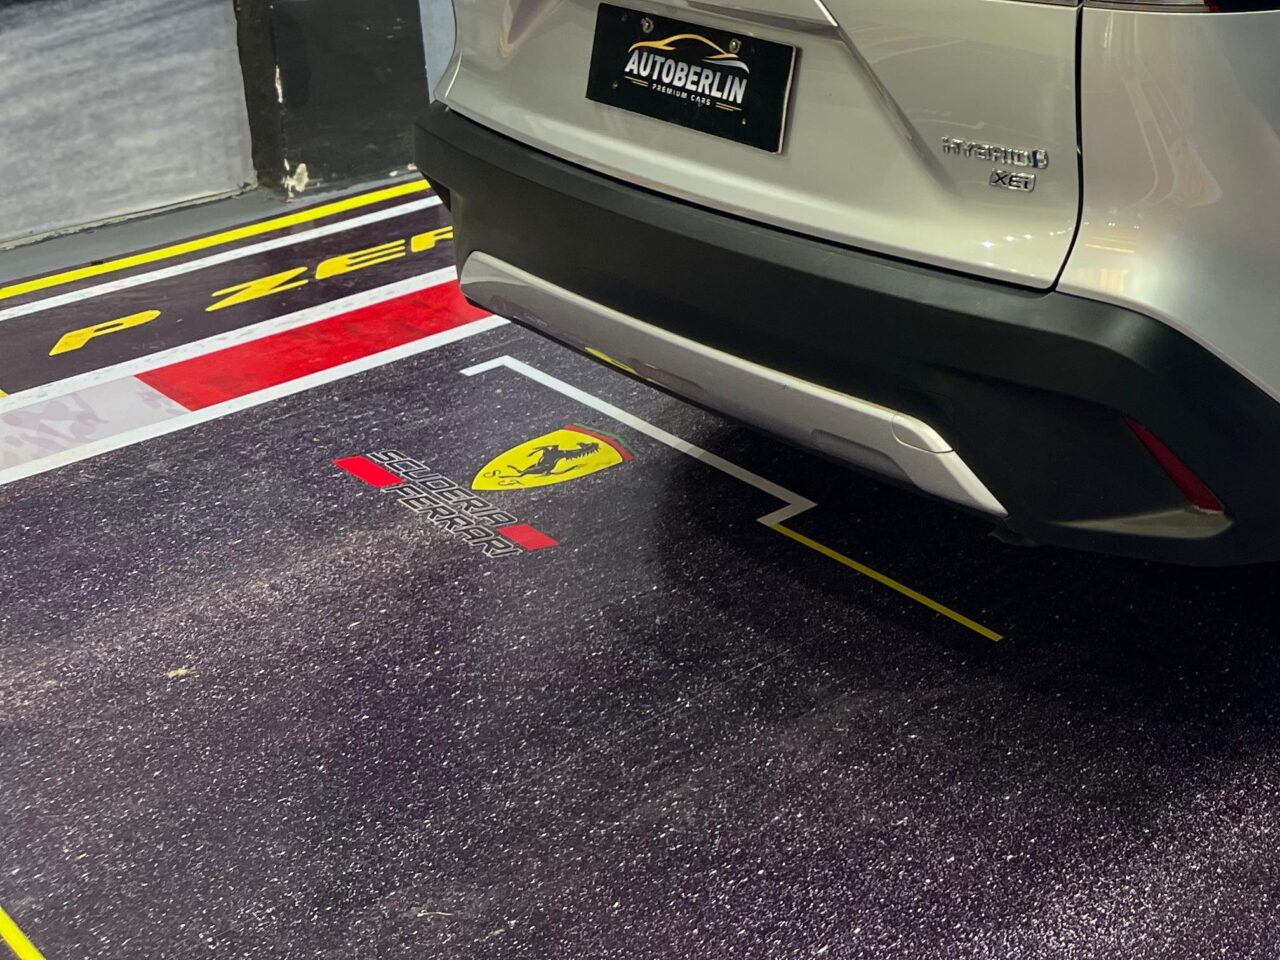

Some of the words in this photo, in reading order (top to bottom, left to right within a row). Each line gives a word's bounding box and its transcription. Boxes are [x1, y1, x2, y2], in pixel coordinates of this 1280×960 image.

[624, 49, 747, 104] AUTOBERLIN
[651, 83, 688, 99] PREMIUM
[690, 94, 711, 106] CARS
[49, 310, 161, 356] P
[367, 449, 518, 526] SCUDERIA
[381, 483, 524, 558] FERRARI
